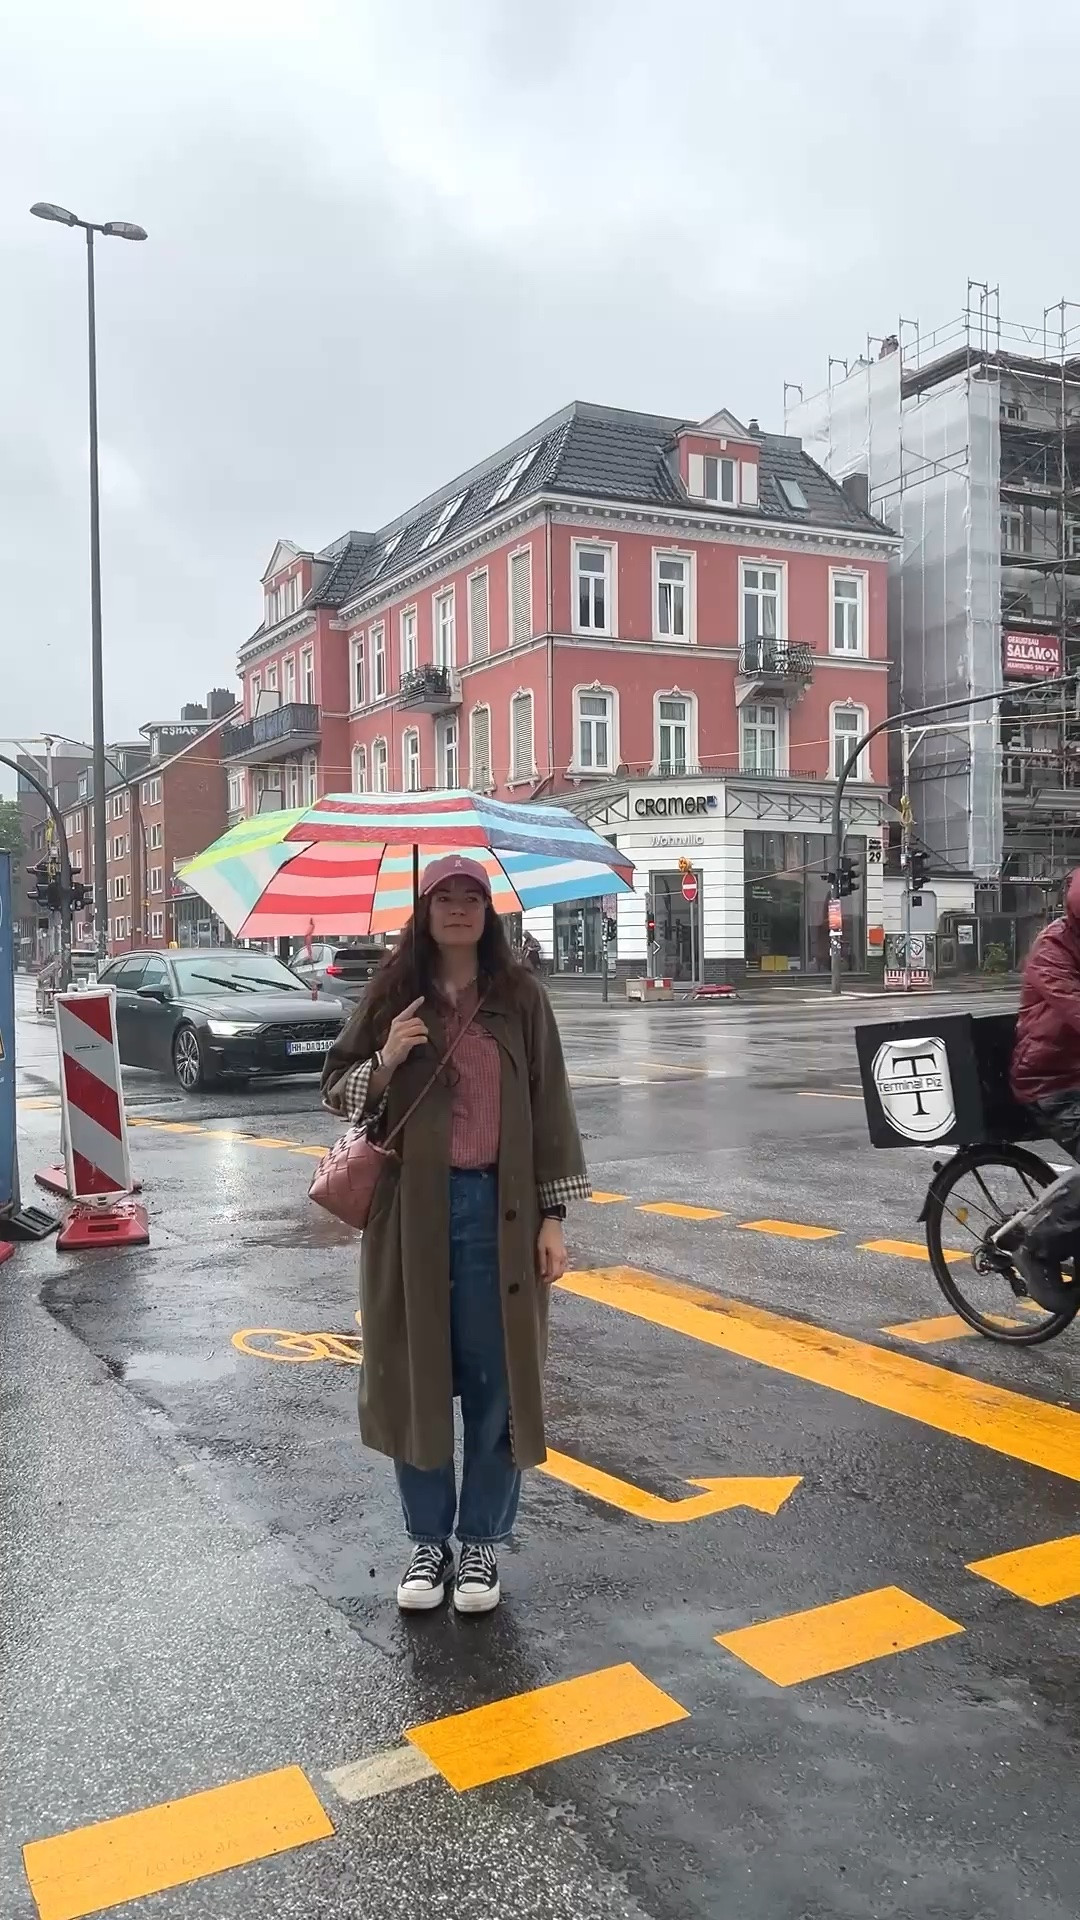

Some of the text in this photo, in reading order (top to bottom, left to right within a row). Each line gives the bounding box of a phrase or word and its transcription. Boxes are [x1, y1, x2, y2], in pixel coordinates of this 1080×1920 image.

[1007, 644, 1058, 661] SALAMON
[869, 851, 881, 862] 29
[877, 1078, 922, 1092] Terminal
